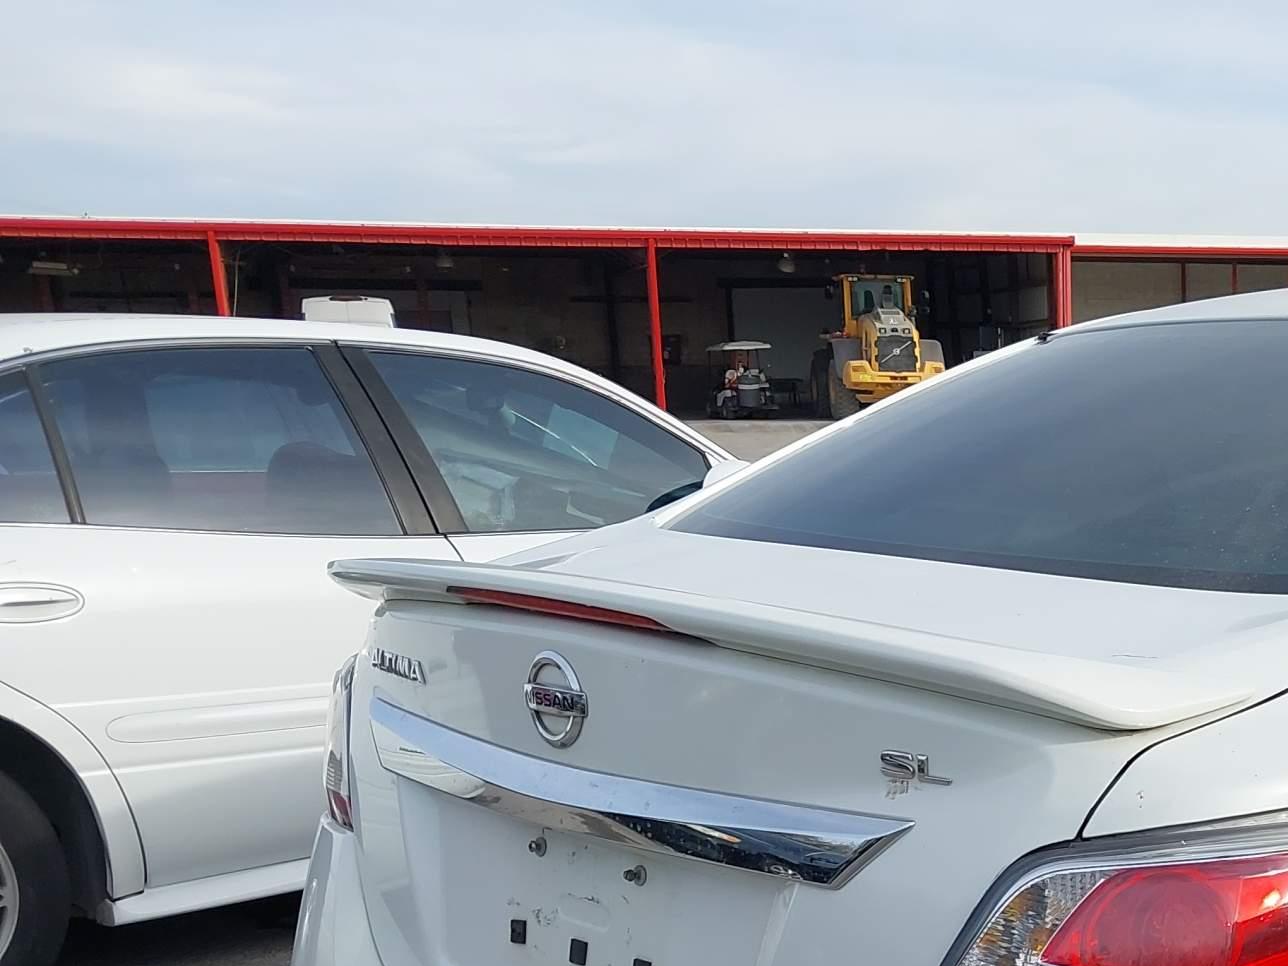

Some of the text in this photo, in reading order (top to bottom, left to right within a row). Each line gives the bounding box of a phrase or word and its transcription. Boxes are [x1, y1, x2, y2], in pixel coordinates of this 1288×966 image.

[371, 648, 426, 684] ALTIMA
[526, 687, 575, 712] NISSAN
[880, 750, 953, 786] SL
